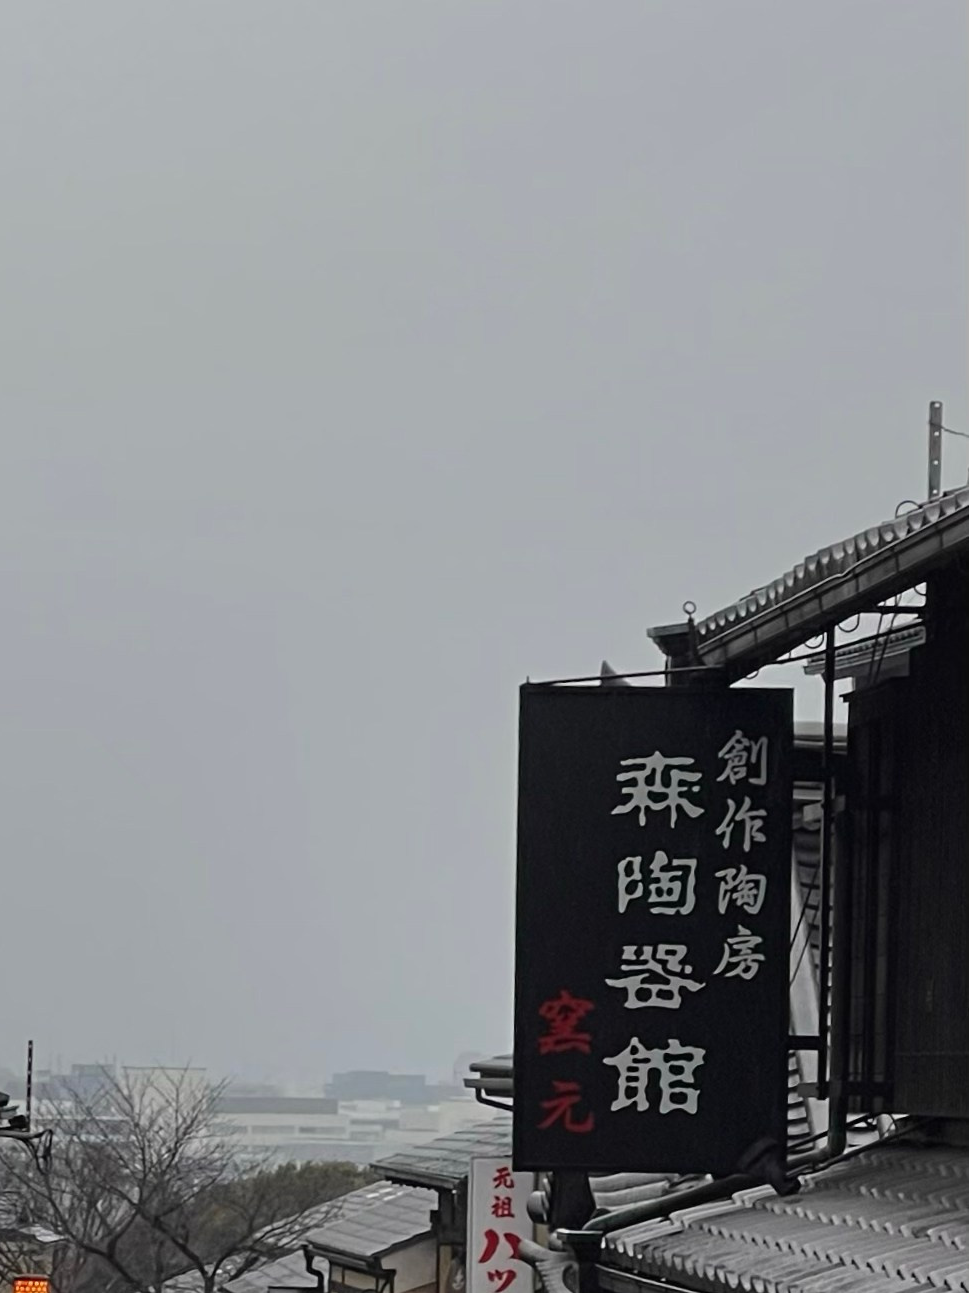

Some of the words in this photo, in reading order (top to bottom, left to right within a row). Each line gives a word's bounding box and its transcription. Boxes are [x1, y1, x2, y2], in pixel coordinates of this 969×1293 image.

[602, 750, 706, 1114] 森陶器館
[714, 730, 769, 981] 創作陶房
[537, 990, 595, 1134] 窯元
